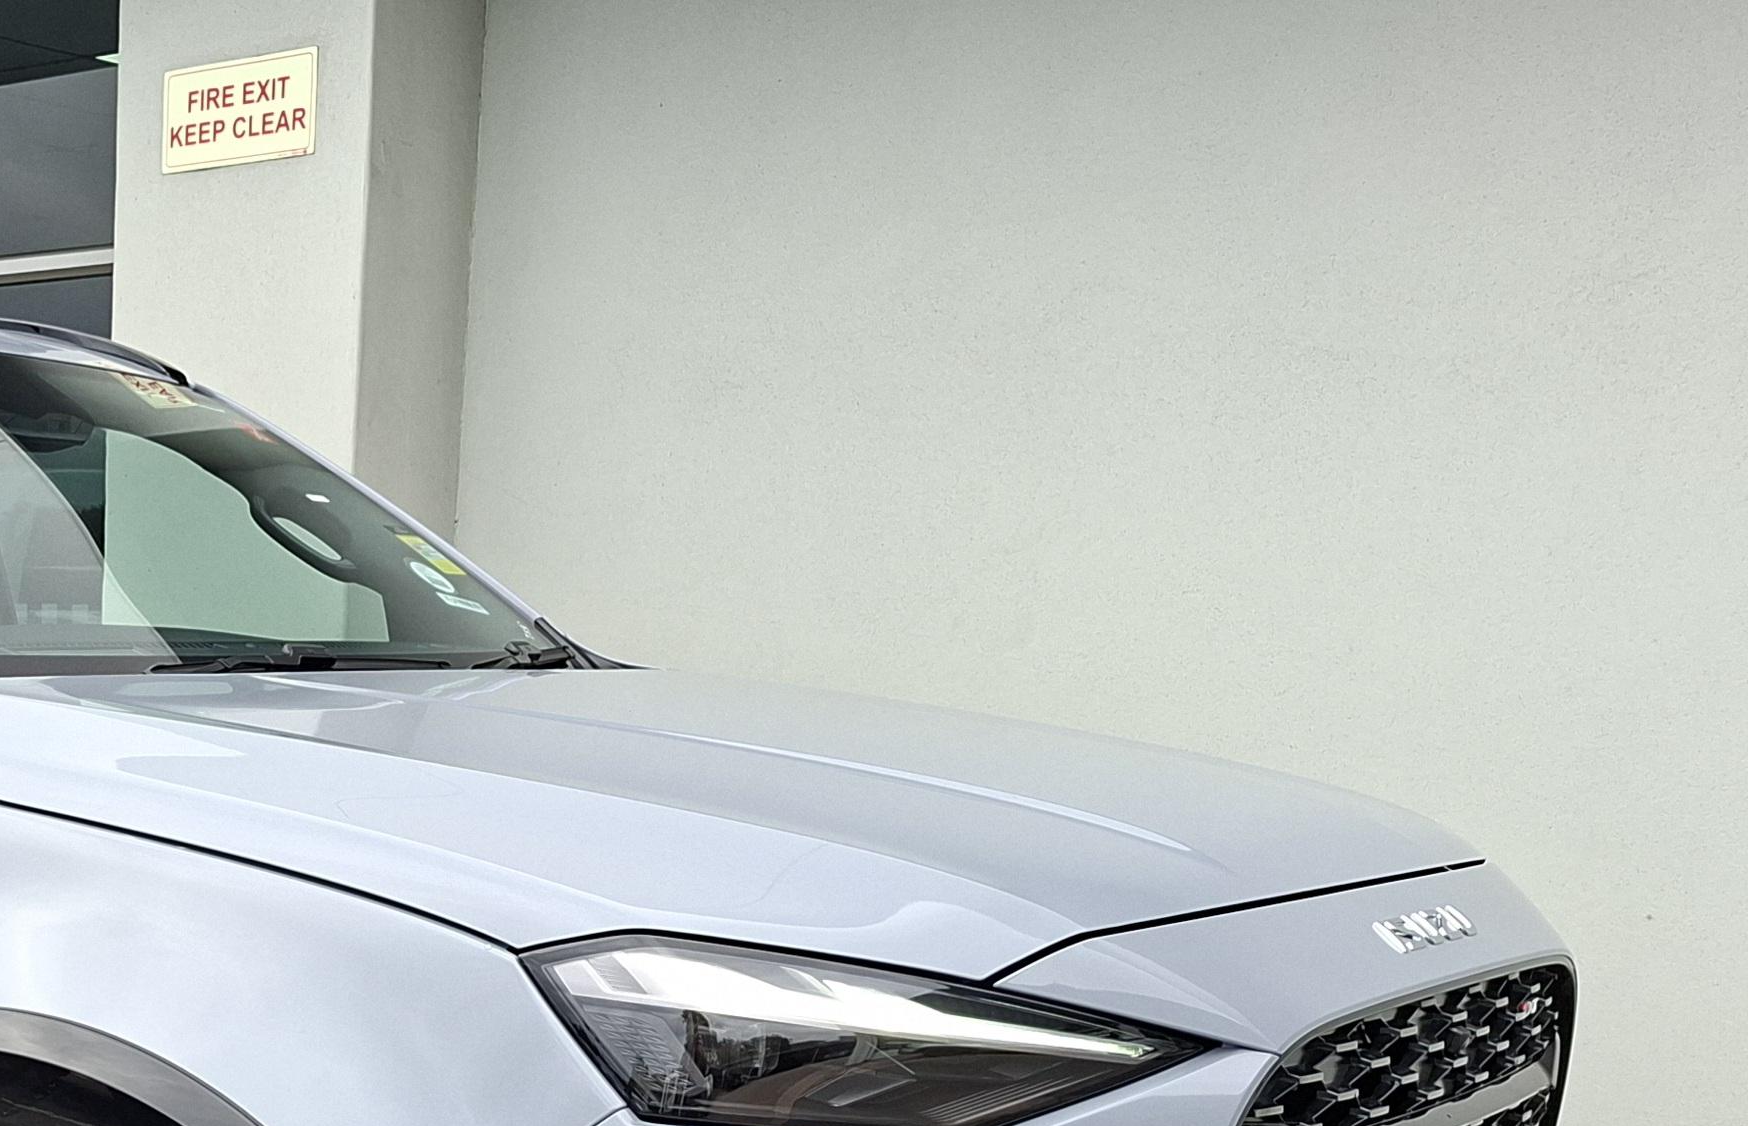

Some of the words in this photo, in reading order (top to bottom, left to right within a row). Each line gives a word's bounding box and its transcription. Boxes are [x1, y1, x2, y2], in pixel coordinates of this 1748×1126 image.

[188, 84, 234, 113] FIRE
[242, 76, 290, 105] EXIT
[170, 119, 226, 149] KEEP
[232, 107, 306, 139] CLEAR
